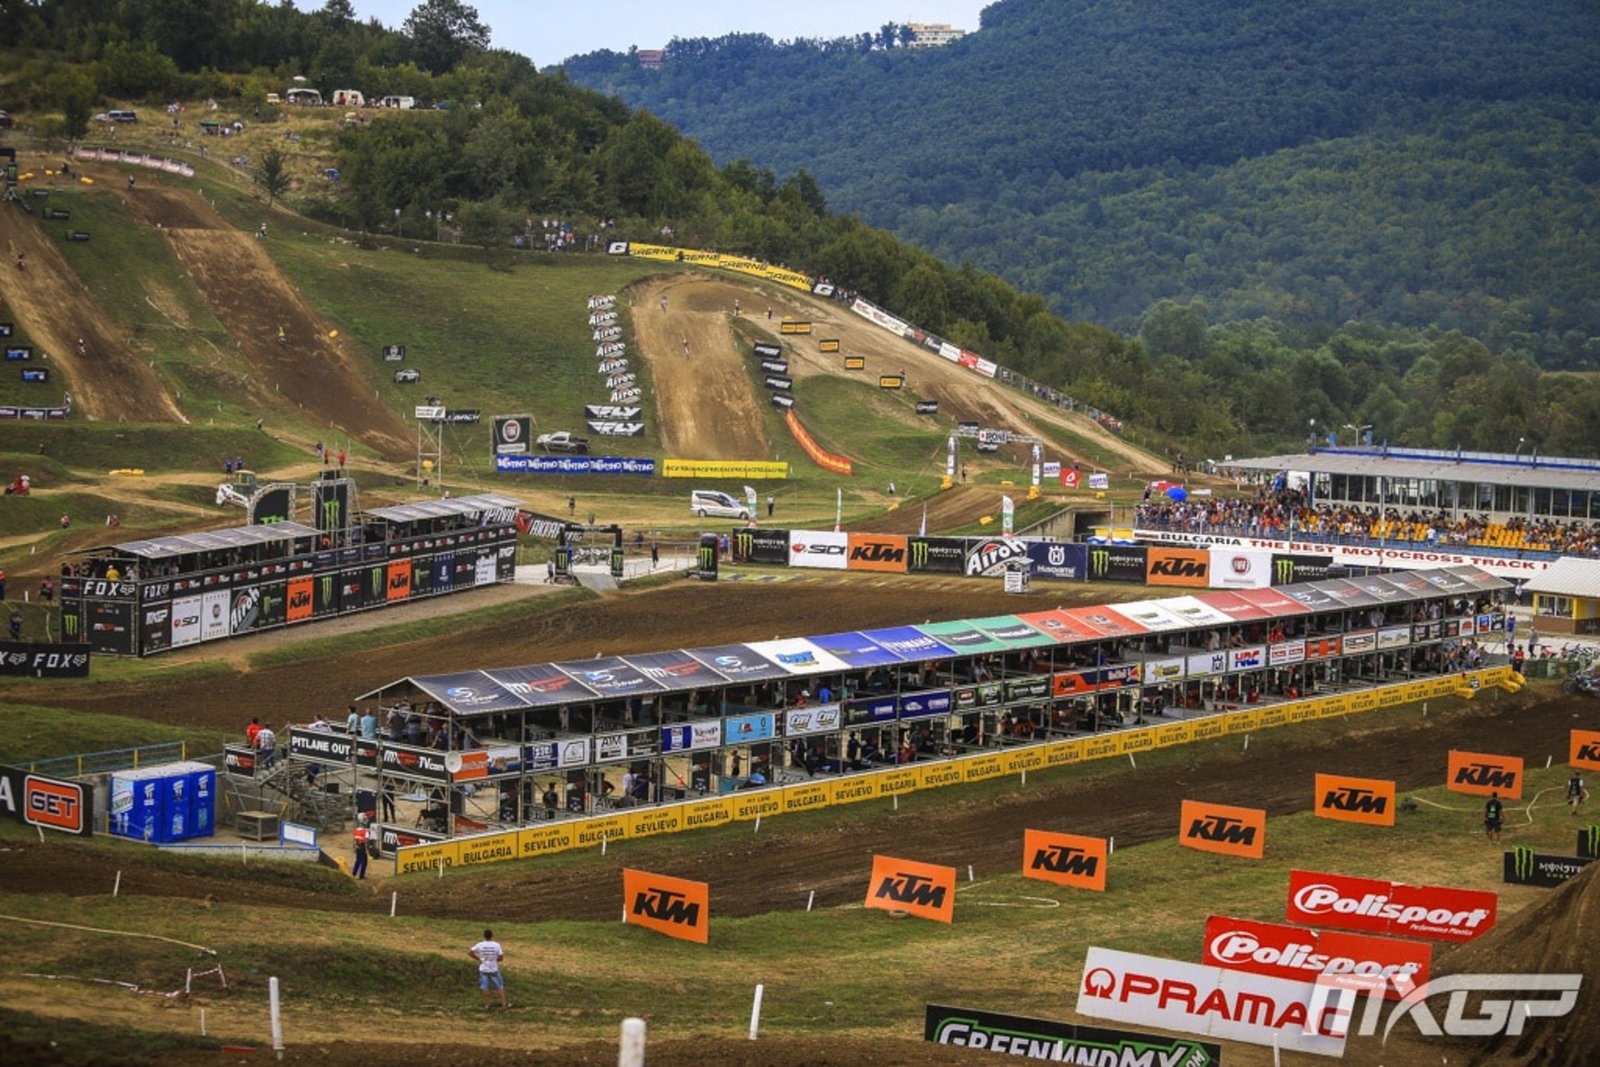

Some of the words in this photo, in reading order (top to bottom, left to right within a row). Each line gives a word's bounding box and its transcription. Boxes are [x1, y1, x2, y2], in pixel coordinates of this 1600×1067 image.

[851, 542, 904, 563] KTM
[966, 537, 1028, 576] Airoh
[1160, 533, 1242, 546] BULGARIA
[1250, 540, 1285, 550] THE
[1290, 543, 1337, 553] BEST
[1342, 546, 1464, 565] MOTOCROSS
[1470, 557, 1536, 570] TRACK
[1150, 557, 1207, 577] KTM
[84, 581, 119, 597] FOX
[389, 573, 409, 590] KTM
[144, 583, 161, 598] FOX
[289, 590, 311, 610] KTM
[33, 653, 73, 668] FOX
[292, 737, 329, 752] PITLANE
[331, 742, 351, 756] OUT
[966, 764, 1001, 778] BULGARIA
[1009, 757, 1041, 770] SEVLIEVO
[925, 771, 960, 785] SEVLIEVO
[1454, 763, 1516, 789] KTM
[835, 785, 873, 800] SEVLIEVO
[881, 778, 917, 793] BULGARIA
[31, 791, 76, 817] GET
[739, 802, 779, 817] SEVLIEVO
[787, 793, 827, 809] BULGARIA
[1322, 787, 1388, 816] KTM
[635, 818, 678, 834] SEVLIEVO
[687, 810, 729, 826] BULGARIA
[579, 827, 624, 844] BULGARIA
[1187, 815, 1257, 846] KTM
[524, 835, 570, 852] SEVLIEVO
[463, 846, 512, 863] BULGARIA
[1031, 844, 1099, 878] KTM
[1539, 861, 1582, 874] MONSTE
[875, 872, 947, 909] KTM
[633, 887, 701, 927] KTM
[1304, 887, 1487, 928] Polisport
[1222, 937, 1418, 983] Polisport
[1120, 972, 1350, 1040] PRAMAC
